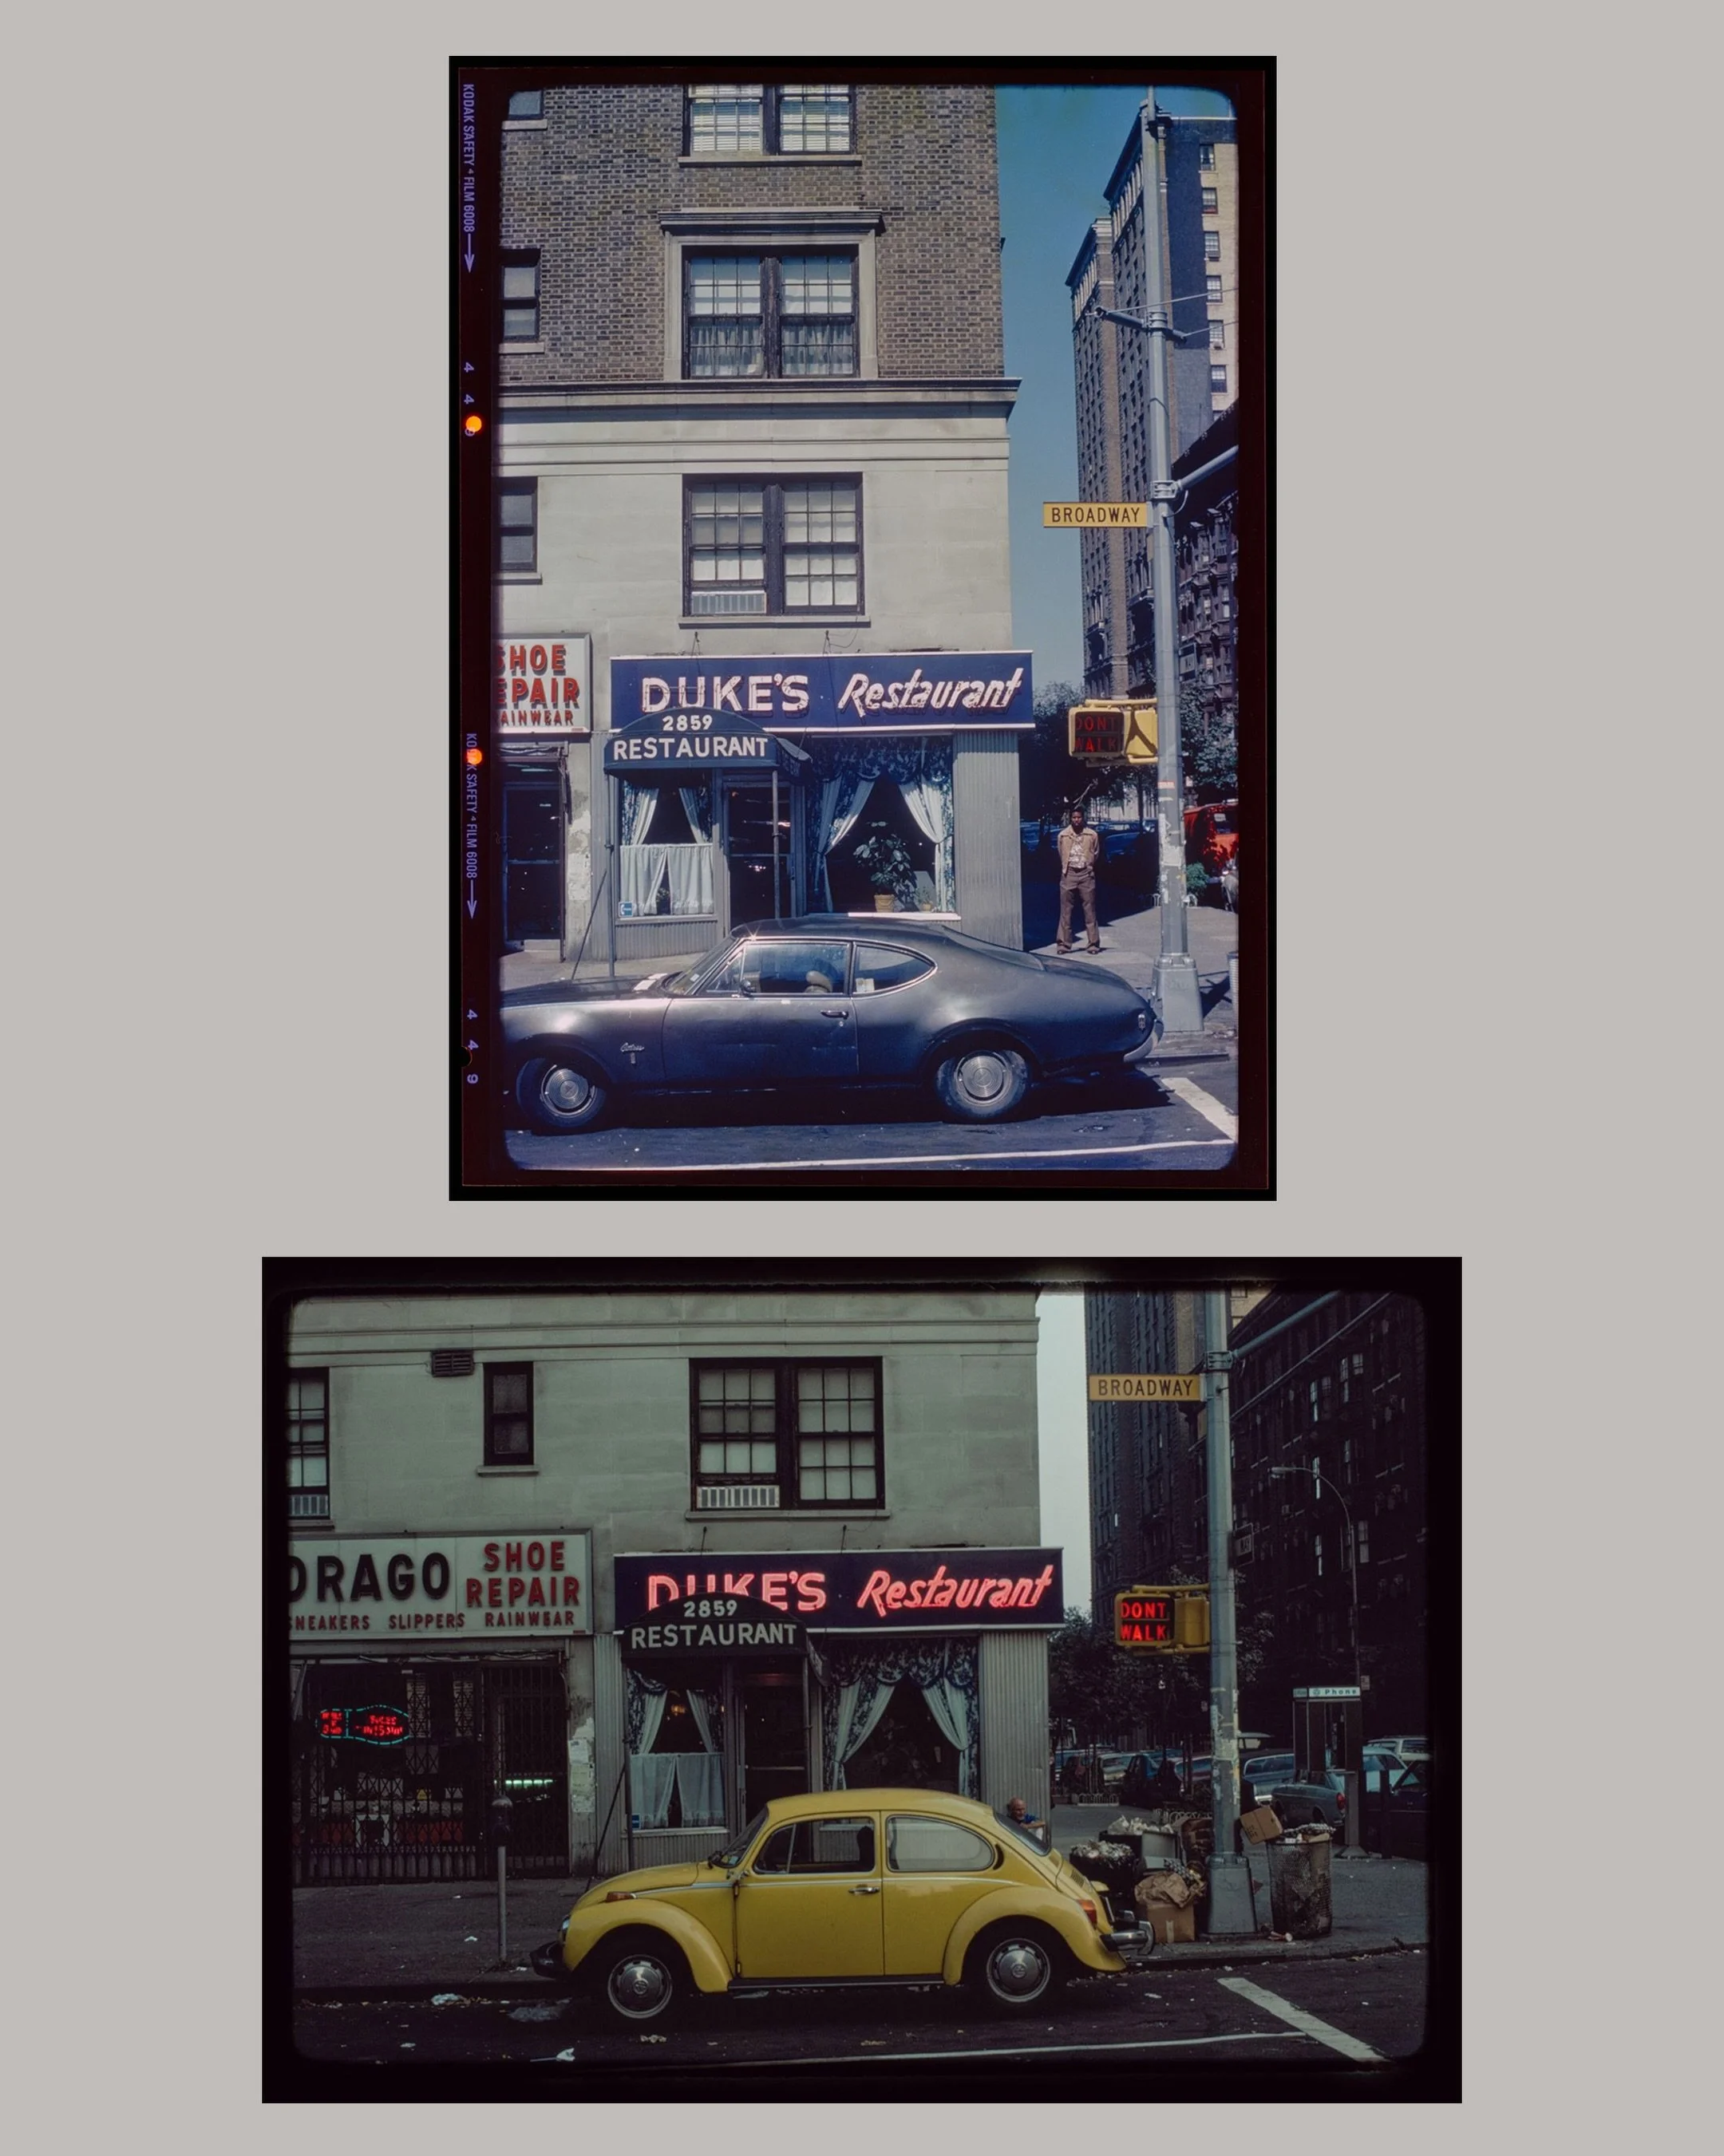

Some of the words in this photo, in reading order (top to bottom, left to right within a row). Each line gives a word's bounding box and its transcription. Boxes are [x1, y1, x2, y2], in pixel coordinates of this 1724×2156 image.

[463, 84, 475, 122] KODAK
[463, 125, 476, 167] SAFETY
[464, 176, 476, 202] FILM
[464, 204, 476, 232] 6008
[1051, 507, 1140, 523] BROADWAY
[642, 673, 810, 713] DUKE'S
[837, 668, 1024, 718] Restaurant
[662, 715, 713, 731] 2859
[466, 732, 477, 771] KOK
[613, 736, 768, 760] RESTAURANT
[466, 773, 477, 814] SAFETY
[466, 823, 477, 848] FILM
[466, 851, 477, 879] 6008
[1098, 1379, 1193, 1396] BROADWAY
[484, 1541, 565, 1573] SHOE
[288, 1552, 450, 1603] DRAGO
[856, 1564, 1054, 1617] Restaurant
[466, 1576, 580, 1608] REPAIR
[389, 1613, 465, 1629] SLIPPERS
[485, 1610, 575, 1628] RAINWEAR
[683, 1600, 737, 1617] 2859
[1121, 1602, 1166, 1619] DONT
[631, 1623, 797, 1649] RESTAURANT
[1121, 1624, 1167, 1641] WALK
